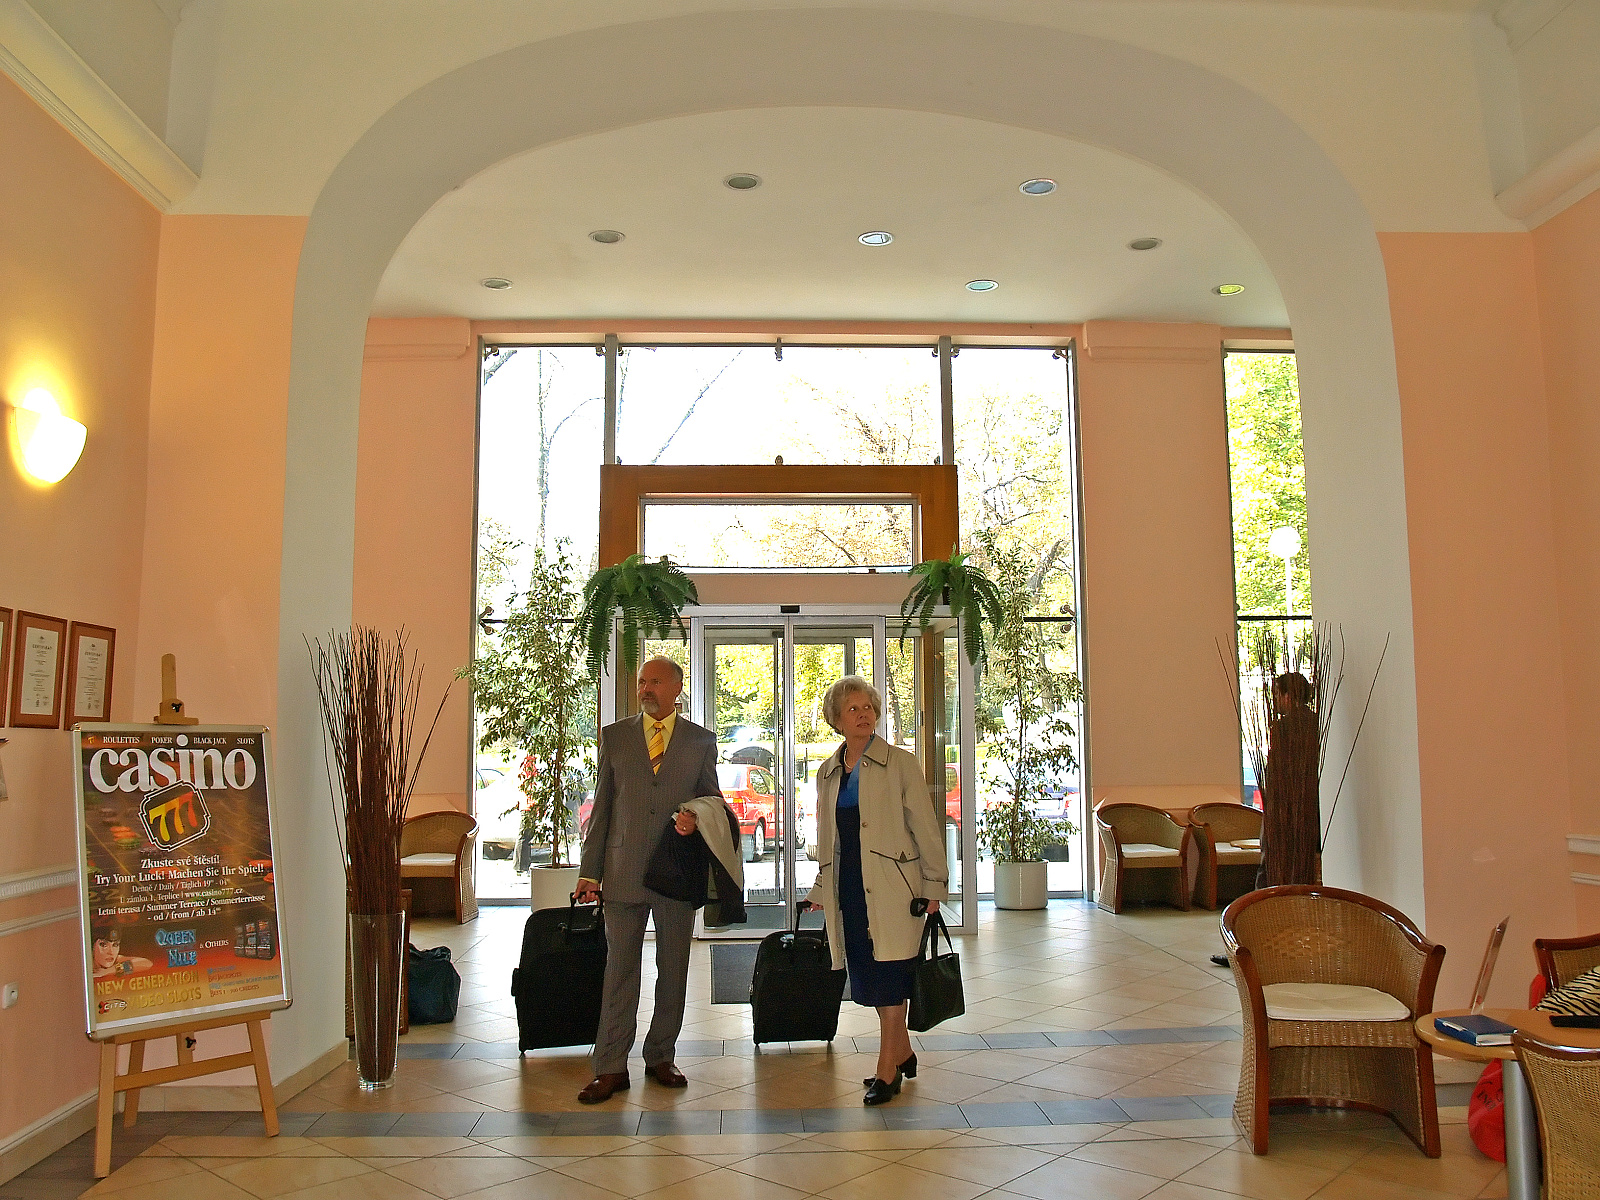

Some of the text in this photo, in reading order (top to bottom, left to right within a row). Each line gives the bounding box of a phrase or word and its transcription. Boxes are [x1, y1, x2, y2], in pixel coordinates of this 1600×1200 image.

[103, 736, 140, 744] ROULETTES
[151, 736, 173, 744] POKER
[213, 737, 227, 745] JACK
[236, 737, 255, 745] SLOTS
[89, 734, 257, 793] casino
[148, 791, 198, 842] 777
[141, 859, 174, 869] Zkuste
[176, 856, 191, 866] své
[95, 863, 264, 886] Try Your Luck! Machen Sie Ihr Spiel!
[158, 882, 175, 891] Daily
[157, 891, 180, 902] Teplice
[184, 888, 243, 898] www.casino777.cz
[118, 906, 141, 914] terasa
[147, 902, 178, 912] Summer
[179, 899, 206, 909] Terrace
[210, 895, 266, 906] Sommerterrasse
[153, 912, 164, 921] od
[171, 910, 190, 919] from
[196, 908, 206, 917] ab
[204, 939, 230, 949] OTHERS
[167, 949, 198, 967] NILE
[96, 979, 126, 996] NEW
[128, 970, 199, 991] GENERATION
[127, 987, 202, 1009] VIDEO SLOTS
